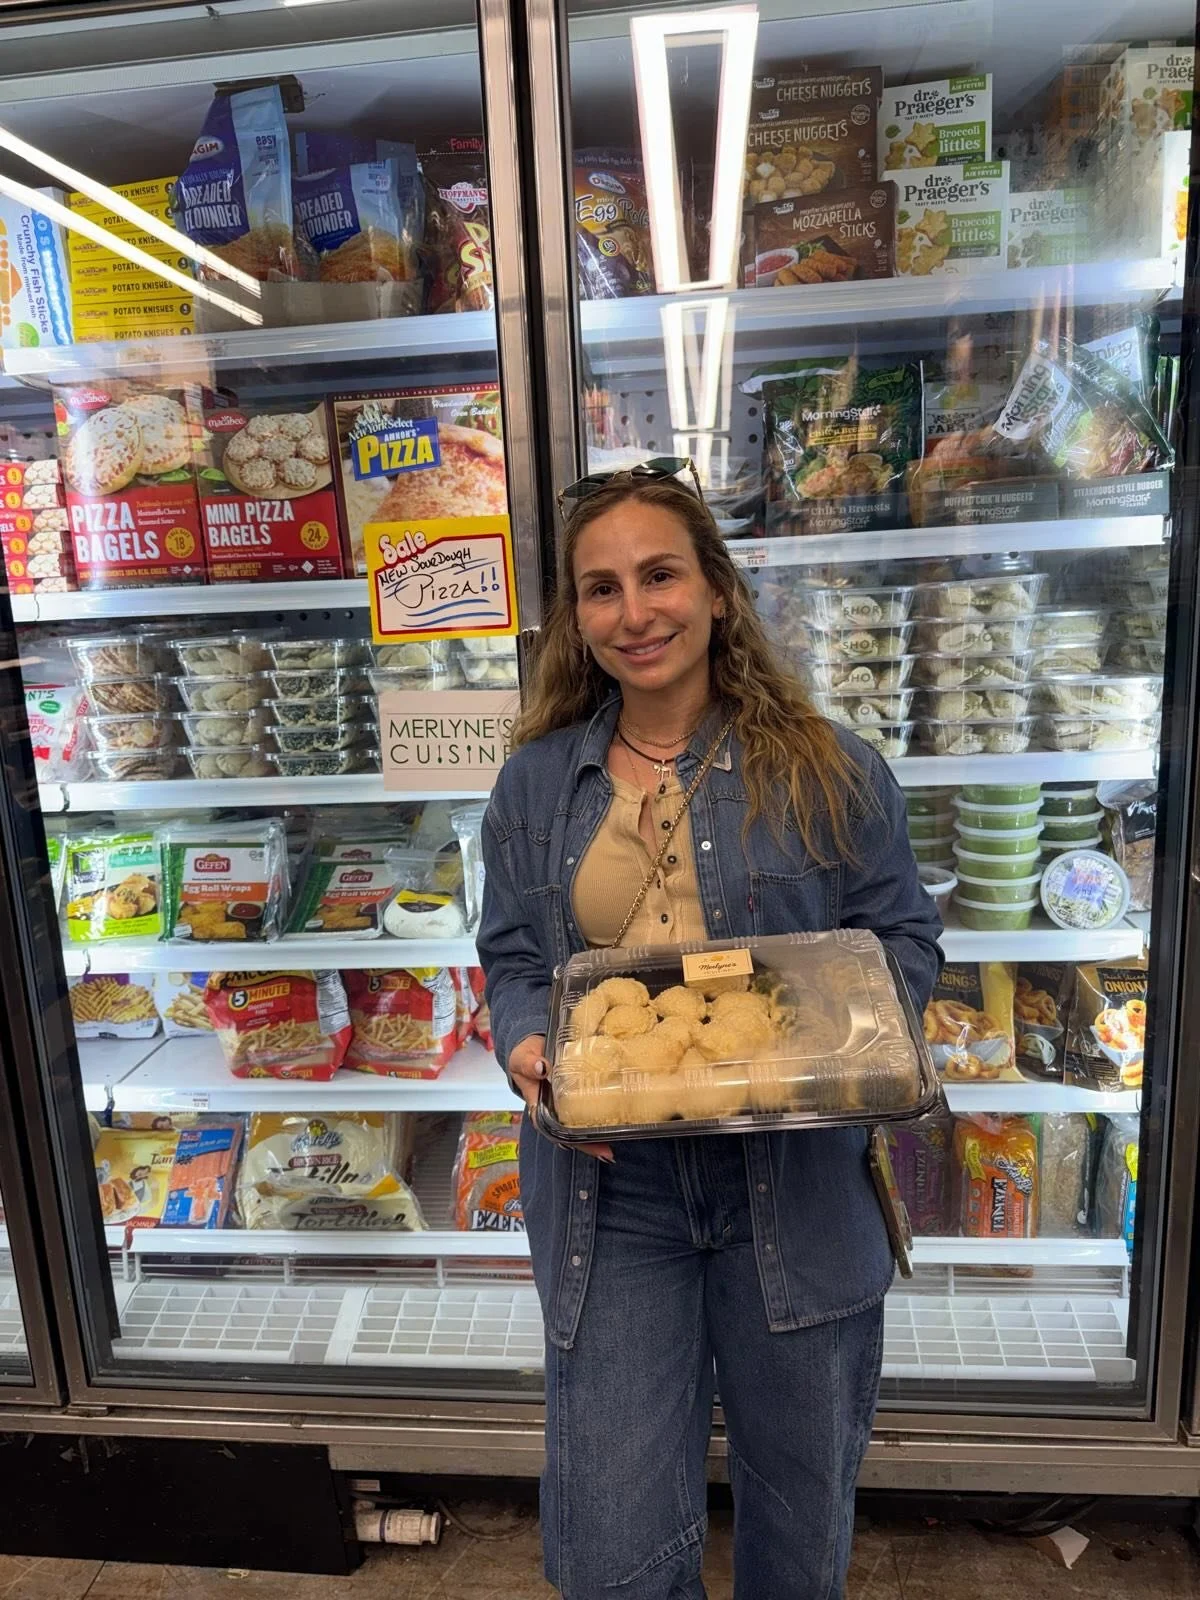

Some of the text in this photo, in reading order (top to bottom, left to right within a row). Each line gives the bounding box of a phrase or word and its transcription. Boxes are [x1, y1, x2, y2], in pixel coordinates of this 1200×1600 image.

[777, 84, 818, 102] CHEESE
[820, 78, 872, 98] NUGGETS
[894, 93, 975, 117] Praeger's
[747, 129, 792, 147] CHEESE
[794, 119, 848, 141] NUGGETS
[939, 125, 980, 139] Broccoli
[255, 134, 277, 147] easy
[450, 137, 484, 150] Family
[939, 138, 981, 153] littles
[131, 185, 160, 196] KNISHES
[181, 180, 232, 208] BREADED
[903, 180, 990, 203] Praeger's
[575, 195, 617, 223] Egg
[184, 204, 242, 231] FLOUNDER
[792, 208, 862, 232] MOZZARELLA
[951, 215, 995, 227] Broccoli
[840, 221, 877, 238] STICKS
[951, 228, 995, 243] littles
[20, 215, 49, 334] Crunchy Fish Sticks
[112, 283, 140, 292] POTATO
[113, 307, 142, 316] POTATO
[143, 304, 174, 314] KNISHES
[114, 330, 142, 339] POTATO
[143, 328, 175, 337] KNISHES
[801, 404, 877, 422] MorningStar
[208, 416, 246, 427] macabee
[348, 427, 370, 444] New
[388, 417, 414, 430] Select
[384, 428, 417, 443] AMNON'S
[356, 434, 435, 475] PIZZA
[1086, 494, 1146, 508] MorningStar
[71, 502, 136, 533] PIZZA
[205, 500, 295, 525] MINI PIZZA
[208, 524, 272, 548] BAGELS
[307, 528, 321, 542] 24
[75, 531, 161, 563] BAGELS
[174, 537, 185, 550] 18
[379, 530, 427, 566] Sale
[378, 564, 408, 587] NEW
[843, 605, 888, 617] SHORE
[389, 718, 513, 739] MERLYNE'S
[196, 860, 228, 870] GEFEN
[341, 873, 371, 882] GEFEN
[183, 884, 251, 894] Egg Roll Wraps
[698, 962, 737, 971] Merlyne's
[941, 973, 977, 986] RINGS
[1104, 980, 1144, 993] ONION
[234, 983, 290, 1007] 5 MINUTE
